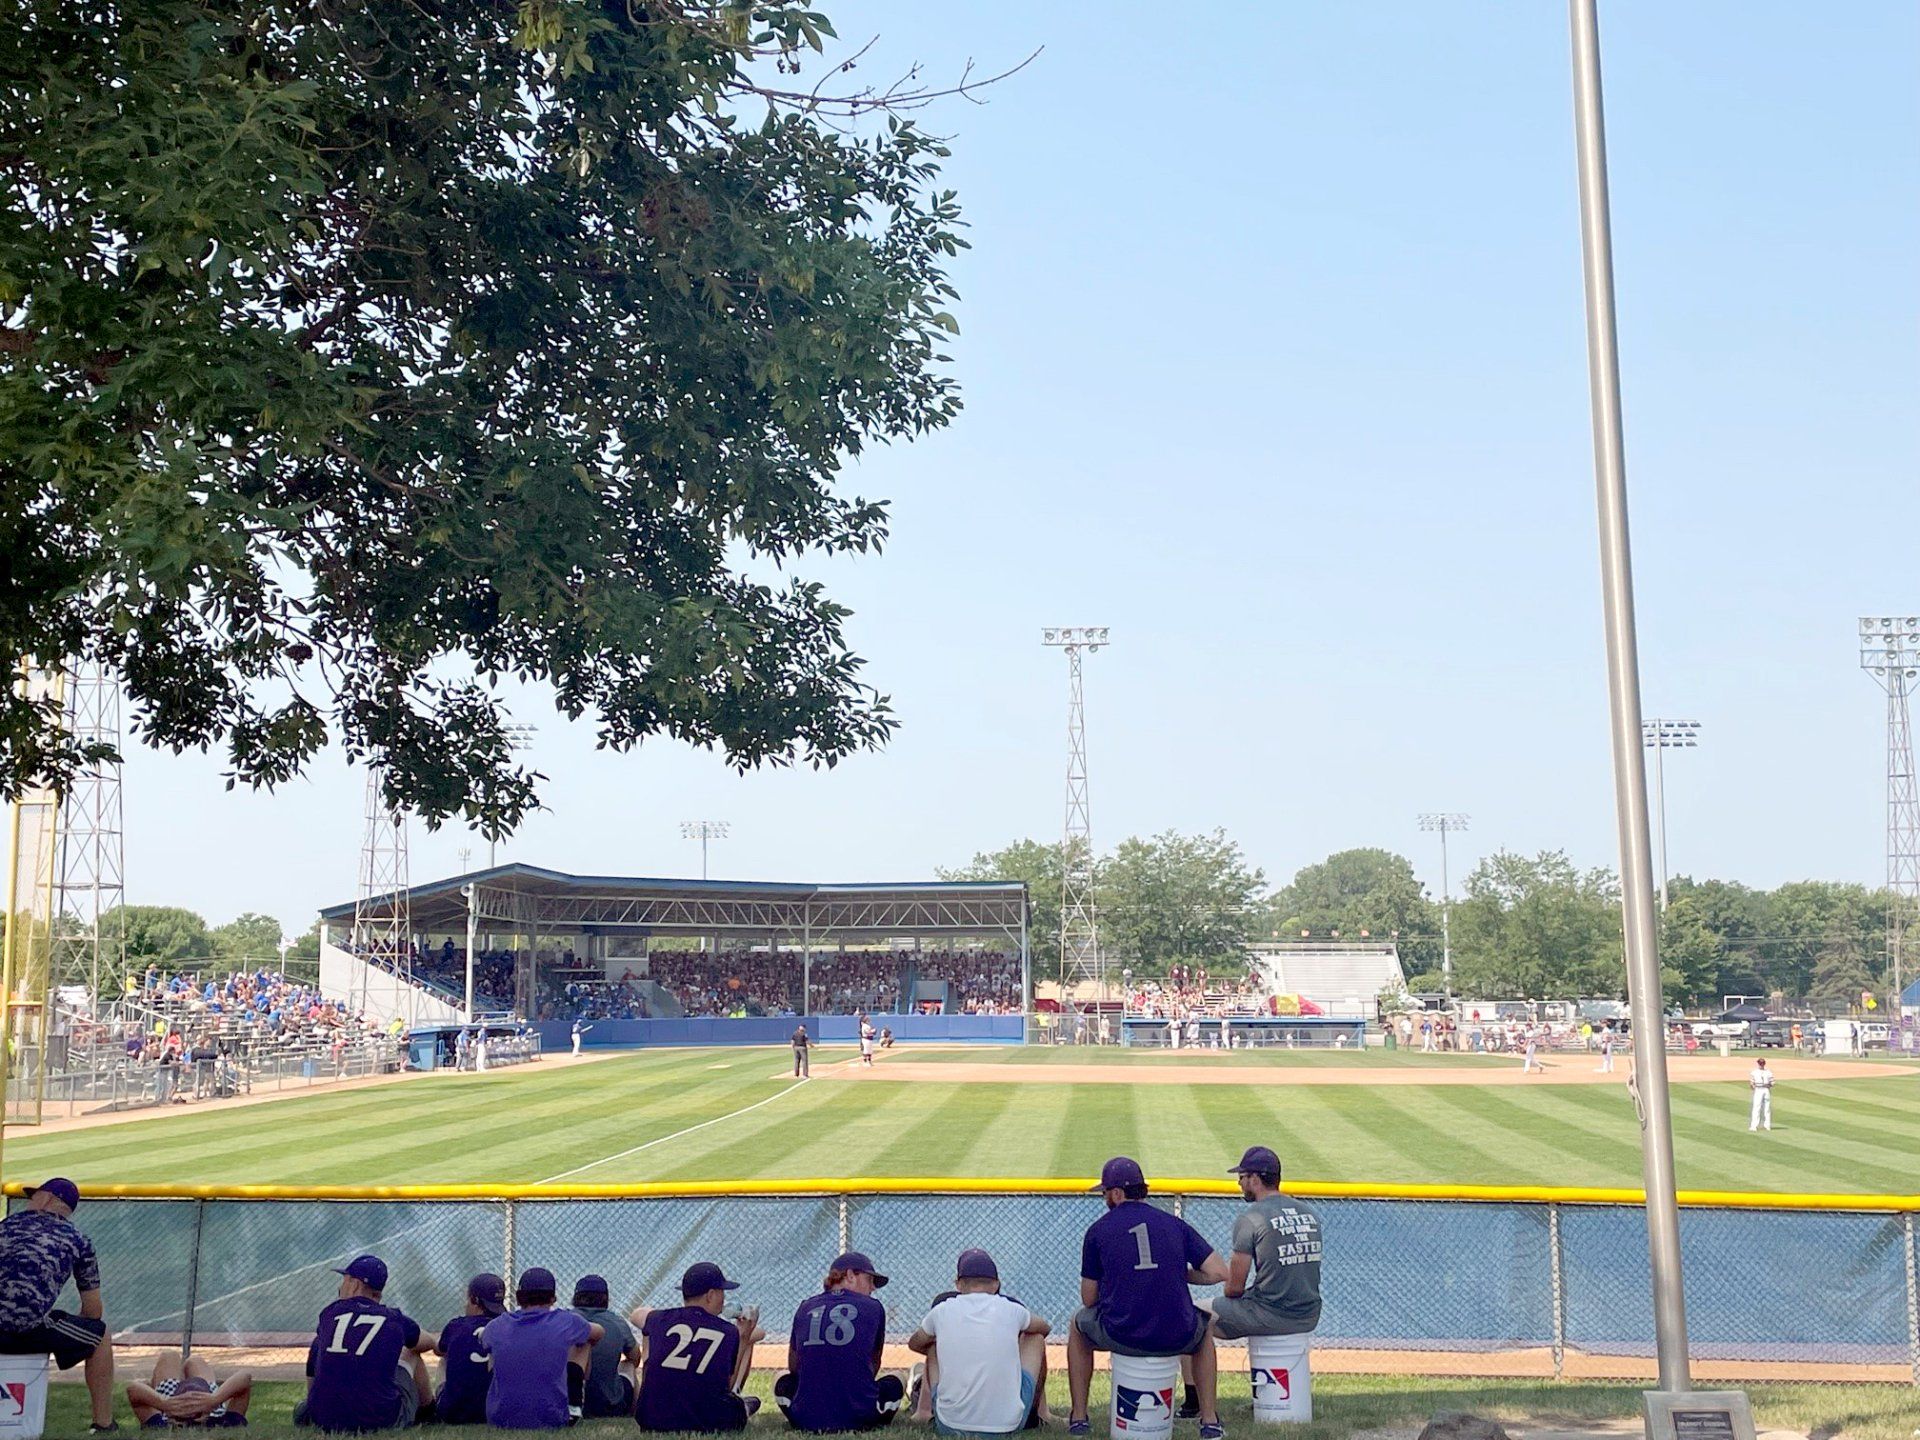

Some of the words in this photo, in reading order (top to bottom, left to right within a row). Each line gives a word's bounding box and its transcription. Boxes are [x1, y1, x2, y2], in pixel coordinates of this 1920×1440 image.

[1281, 1207, 1298, 1215] THE
[1270, 1213, 1318, 1230] FASTER
[1278, 1226, 1296, 1236] YOU
[1293, 1233, 1310, 1242] THE
[1128, 1222, 1158, 1270] 1
[1277, 1240, 1322, 1257] FASTER
[326, 1311, 387, 1356] 17
[803, 1303, 859, 1347] 18
[661, 1323, 726, 1375] 27
